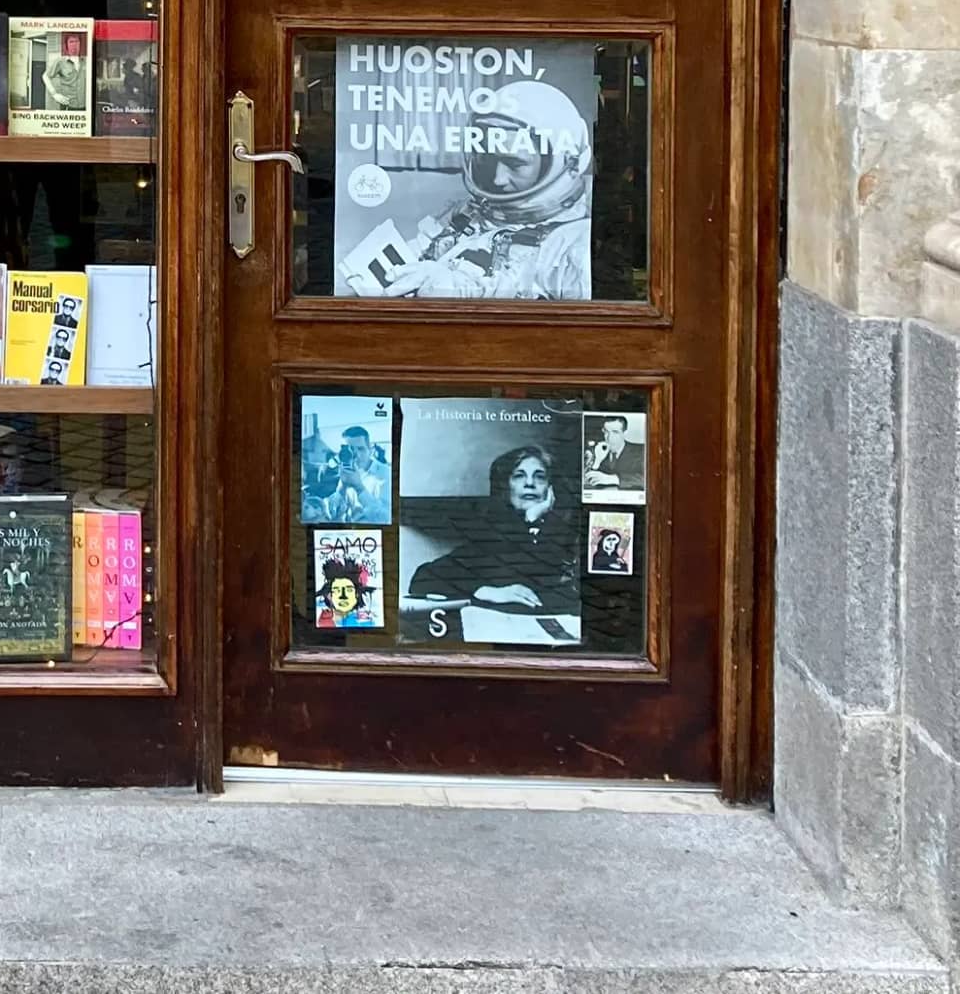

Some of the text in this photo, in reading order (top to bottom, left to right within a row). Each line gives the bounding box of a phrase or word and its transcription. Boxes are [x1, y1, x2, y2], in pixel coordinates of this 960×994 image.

[349, 45, 546, 80] HUOSTON,
[348, 84, 520, 115] TENEMOS
[349, 124, 580, 156] UNA ERRATA
[12, 280, 53, 299] Manual
[12, 299, 60, 315] corsario
[417, 408, 552, 423] La Historia te fortalece
[8, 528, 30, 537] MIL
[32, 528, 41, 537] Y
[2, 538, 51, 548] NOCHES
[319, 536, 377, 555] SAMO
